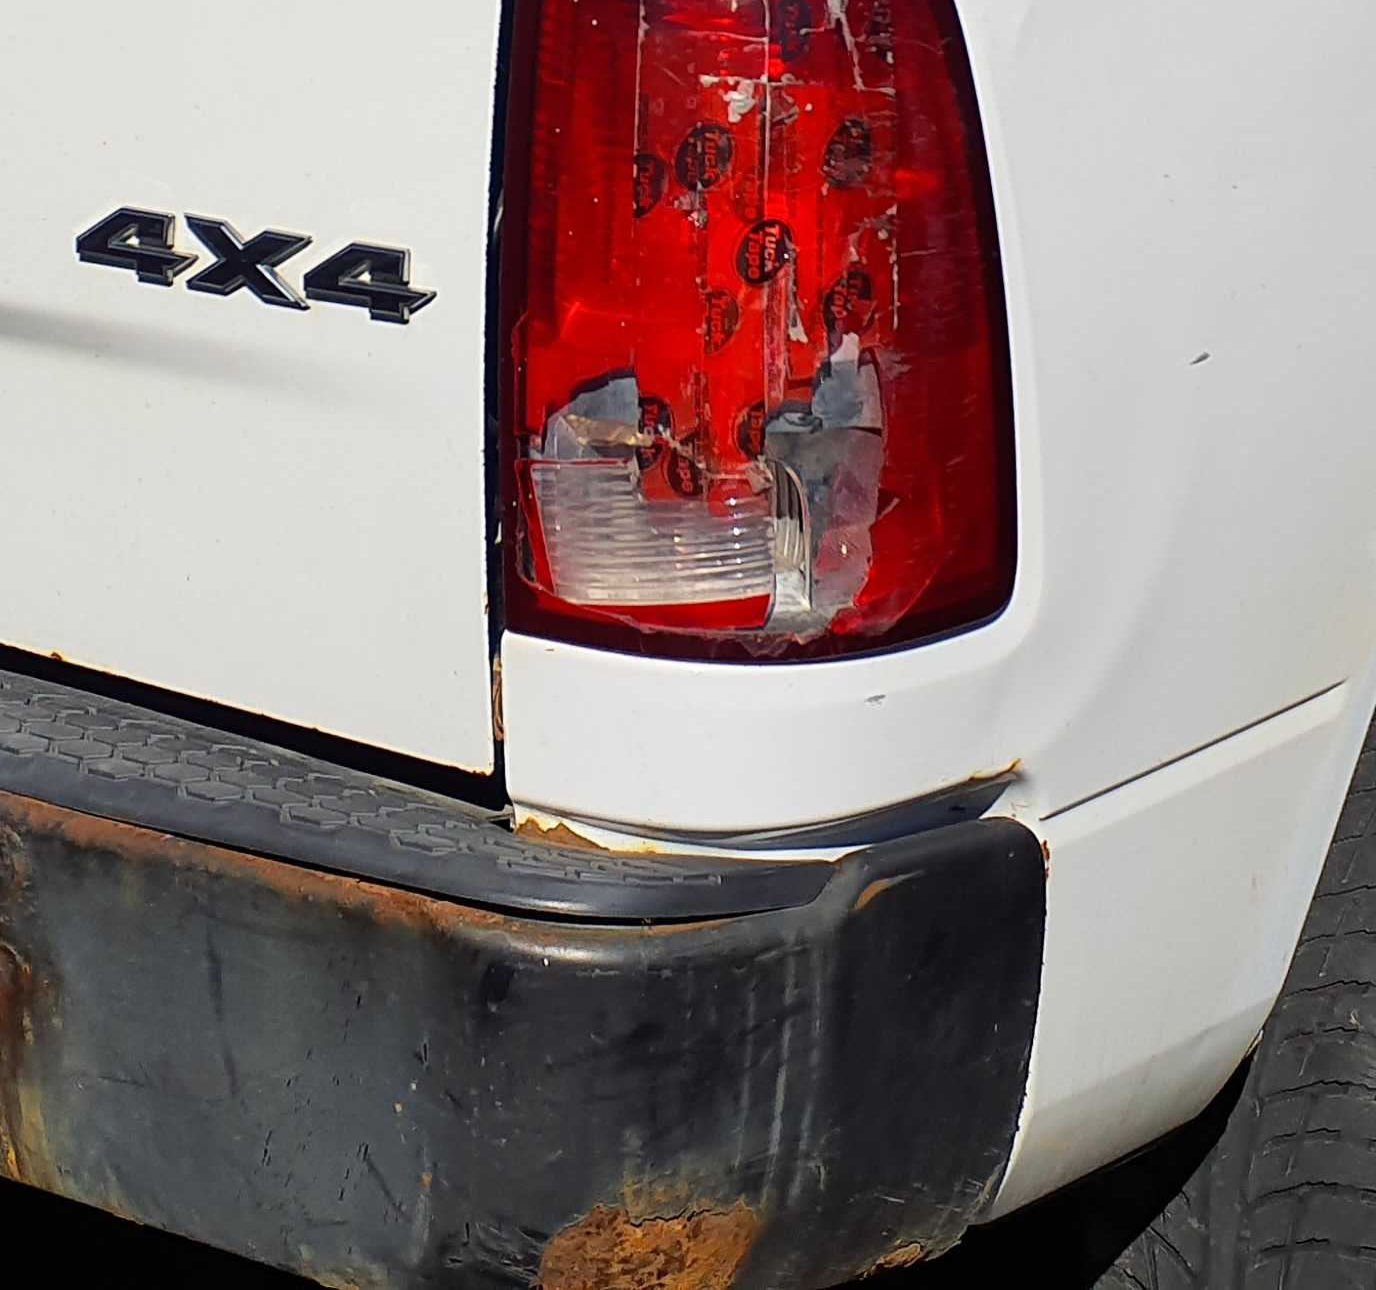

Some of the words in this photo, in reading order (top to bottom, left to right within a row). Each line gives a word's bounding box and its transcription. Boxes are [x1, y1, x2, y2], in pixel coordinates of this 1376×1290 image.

[704, 131, 722, 181] Tuck
[747, 231, 764, 279] Tape
[764, 224, 780, 273] Tuck
